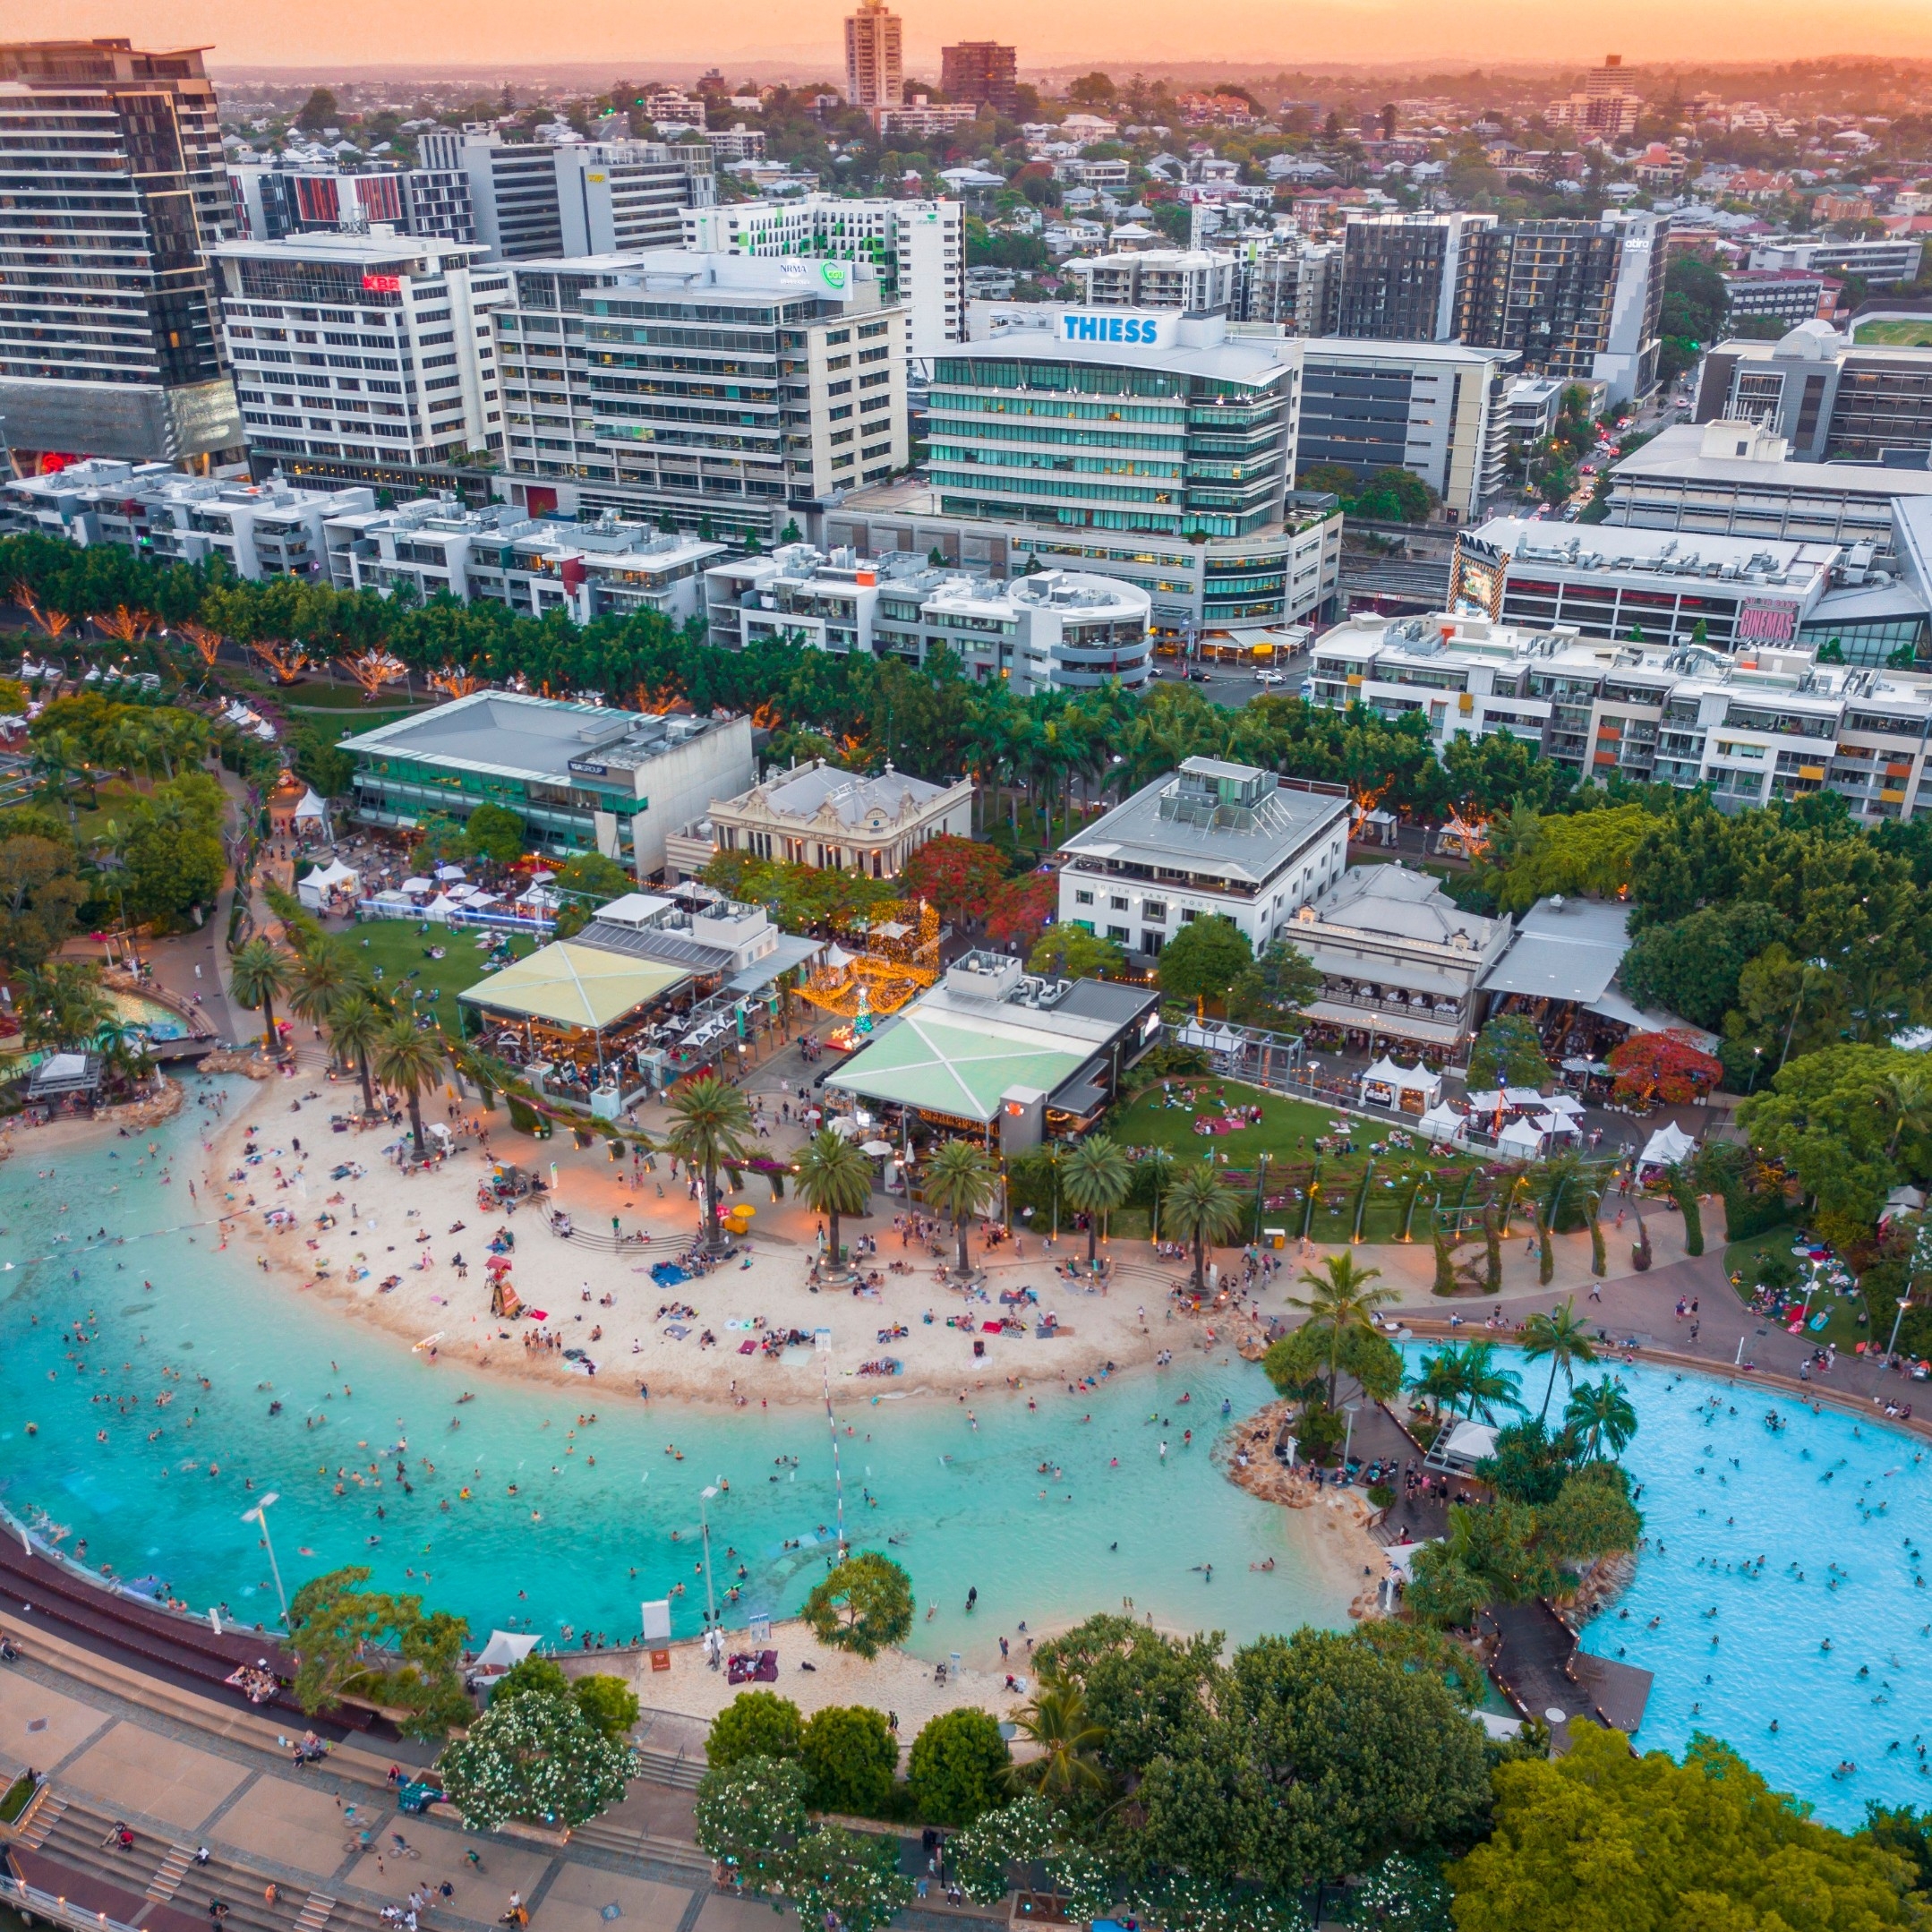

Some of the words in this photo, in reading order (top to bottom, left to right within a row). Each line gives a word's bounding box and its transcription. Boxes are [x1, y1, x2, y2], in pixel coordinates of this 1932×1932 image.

[1626, 238, 1649, 248] atira
[780, 264, 808, 273] NRMA
[1064, 316, 1158, 344] THIESS
[1774, 599, 1798, 609] BANK
[1739, 609, 1794, 640] CINEMAS
[1093, 883, 1130, 893] SOUTH
[1141, 891, 1169, 901] BANK
[1180, 898, 1219, 910] HOUSE
